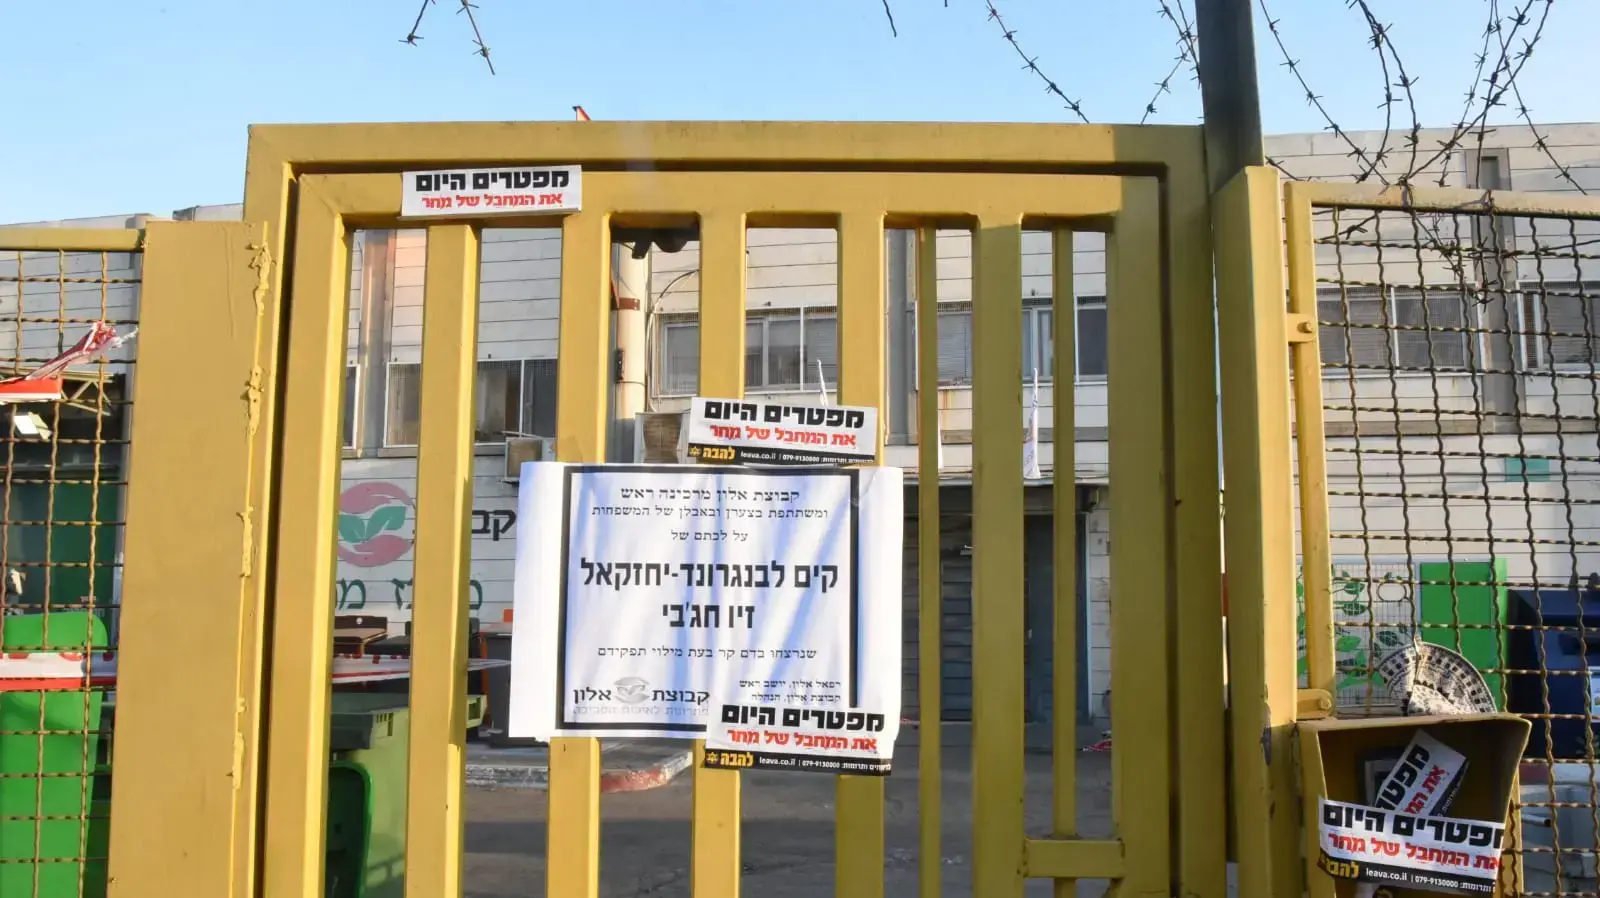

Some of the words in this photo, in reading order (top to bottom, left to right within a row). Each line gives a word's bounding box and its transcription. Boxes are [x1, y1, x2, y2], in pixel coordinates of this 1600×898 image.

[416, 173, 466, 192] היום
[473, 170, 569, 190] מפטרים
[422, 196, 452, 209] מחר
[456, 194, 480, 208] של
[484, 193, 535, 207] המחבל
[538, 192, 562, 206] את
[704, 401, 757, 421] היום
[764, 405, 864, 429] מפטרים
[710, 424, 741, 440] מחר
[746, 425, 770, 440] של
[775, 427, 828, 445] המחבל
[831, 433, 856, 446] את
[703, 446, 735, 460] להבה
[740, 451, 776, 460] leava.co.il
[621, 487, 653, 499] ראש
[658, 487, 711, 500] מרכינה
[717, 487, 748, 502] אלון
[753, 490, 800, 504] קבוצת
[592, 505, 650, 516] המשפחות
[655, 504, 674, 516] של
[679, 505, 720, 521] ובאבלן
[726, 507, 762, 521] בצערן
[768, 508, 828, 519] ומשתתפת
[671, 529, 689, 541] של
[694, 529, 727, 541] לכתם
[733, 529, 749, 543] על
[581, 557, 785, 591] לבנגרונד-יחזקאל
[794, 564, 838, 593] קים
[662, 601, 720, 628] חג'בי
[728, 605, 755, 628] זיו
[598, 647, 647, 659] תפקידם
[652, 645, 683, 657] מילוי
[688, 648, 713, 658] בעת
[718, 648, 736, 661] קר
[740, 648, 765, 659] בדם
[770, 648, 817, 660] שנרצחו
[739, 680, 760, 688] ראש
[763, 680, 786, 688] יושב
[816, 679, 841, 689] רפאל
[573, 686, 611, 704] אלון
[652, 689, 710, 706] קבוצת
[811, 693, 841, 702] קבוצת
[722, 704, 776, 725] היום
[782, 707, 885, 732] מפטרים
[728, 729, 760, 744] מחר
[764, 730, 790, 745] של
[794, 731, 848, 750] המחבל
[852, 736, 877, 750] את
[720, 752, 754, 767] להבה
[759, 756, 796, 766] leava.co.il
[1375, 743, 1430, 811] מפטר
[1323, 803, 1386, 832] היום
[1327, 832, 1366, 853] מחר
[1370, 837, 1400, 857] של
[1405, 842, 1471, 867] המחבל
[1365, 867, 1408, 881] leava.co.il
[1414, 875, 1459, 888] 079-9130000
